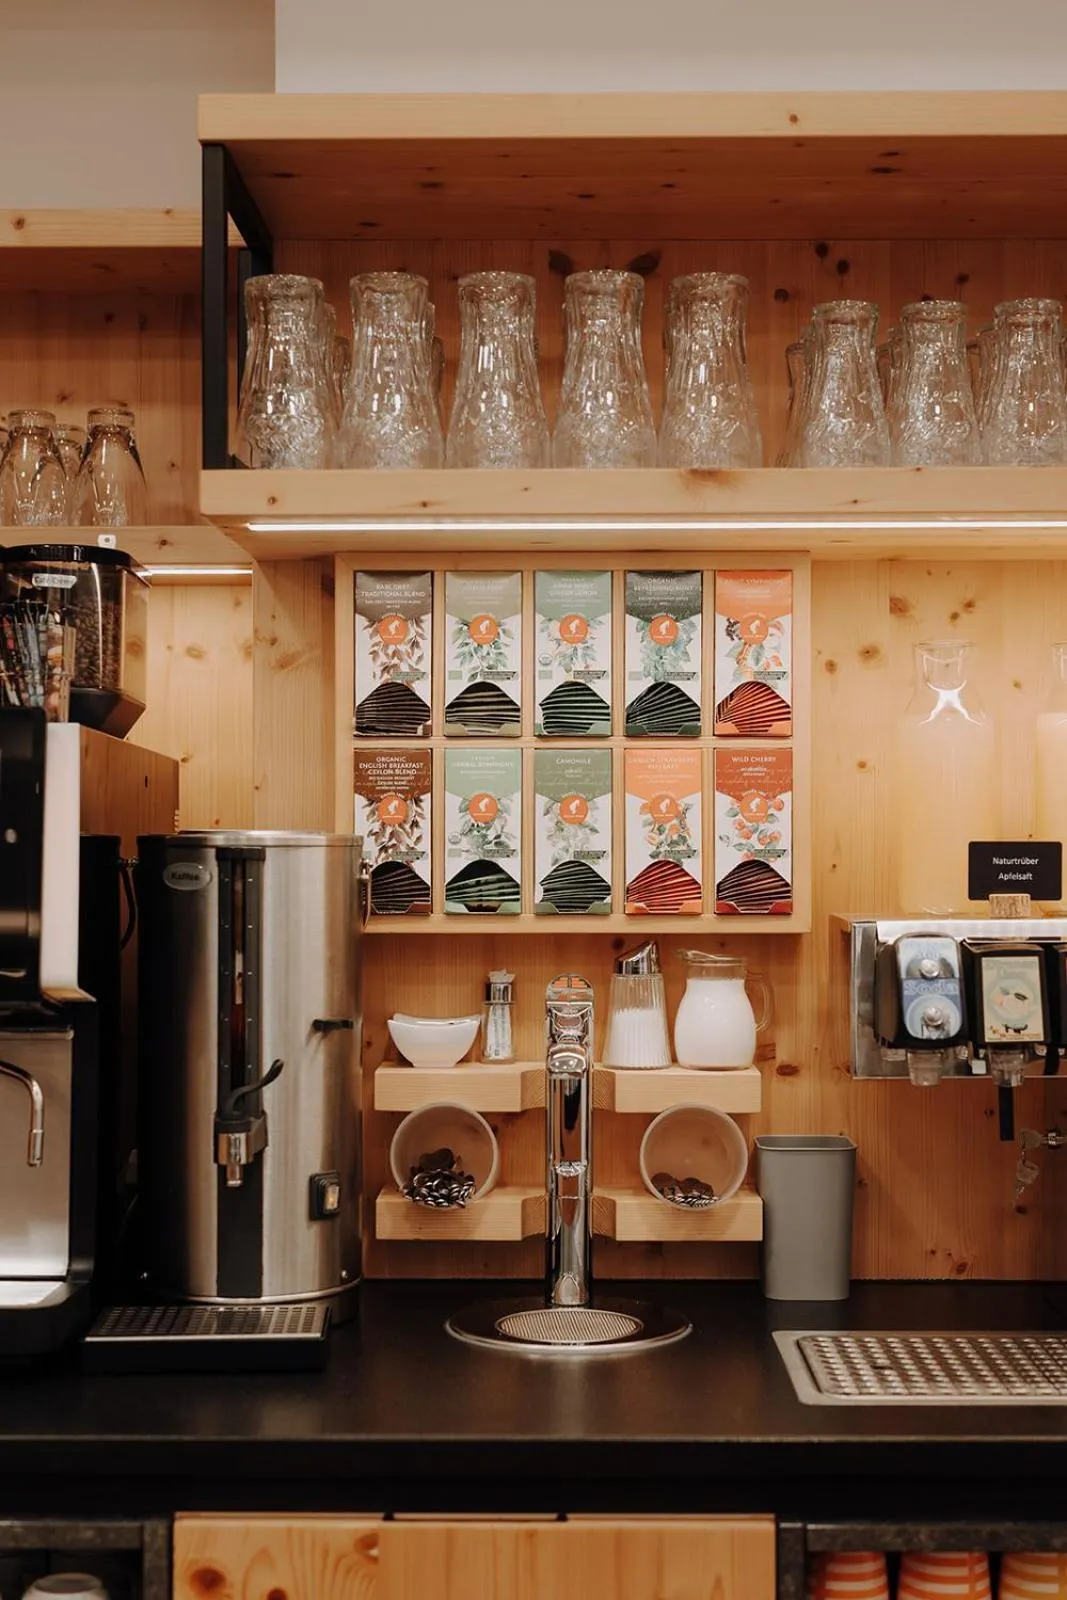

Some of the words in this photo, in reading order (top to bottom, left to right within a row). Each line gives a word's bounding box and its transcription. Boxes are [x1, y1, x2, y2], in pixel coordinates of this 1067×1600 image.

[992, 856, 1039, 865] Naturtrüber
[171, 872, 200, 880] Kaffee
[998, 872, 1033, 881] Apfelsaft
